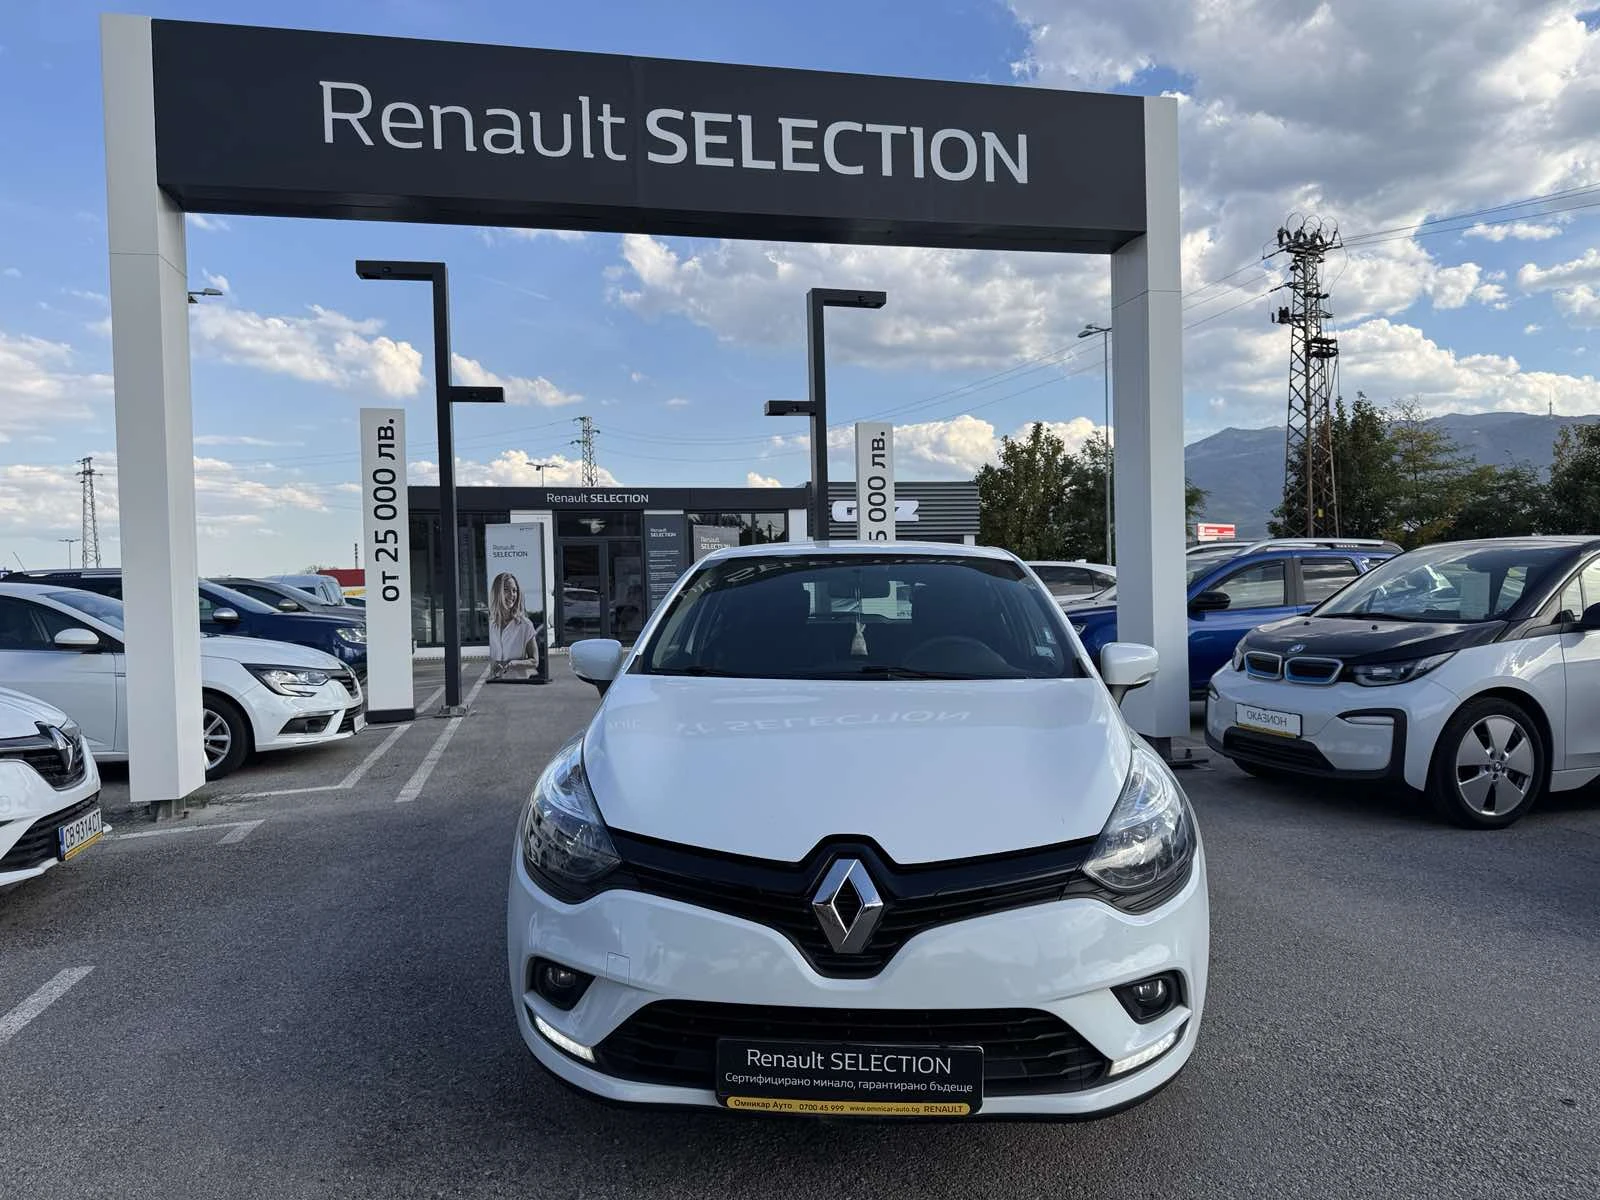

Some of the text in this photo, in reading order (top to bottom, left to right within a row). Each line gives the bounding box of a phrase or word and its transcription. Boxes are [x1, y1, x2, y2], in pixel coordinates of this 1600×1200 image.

[318, 80, 1029, 185] Renault SELECTION
[372, 468, 398, 521] 000
[546, 493, 649, 503] Renault SELECTION
[867, 475, 888, 523] 000
[375, 529, 399, 563] 25
[1246, 710, 1288, 727] ОКАЗИОН
[746, 1049, 951, 1075] Renault SELECTION
[725, 1072, 973, 1093] Сертифицирано минало, гарантирано бъдеще
[734, 1099, 771, 1110] Омникар
[772, 1101, 793, 1110] Ауто
[799, 1102, 818, 1111] 0700
[819, 1103, 829, 1111] 45
[830, 1104, 845, 1112] 999
[923, 1105, 964, 1113] RENAULT
